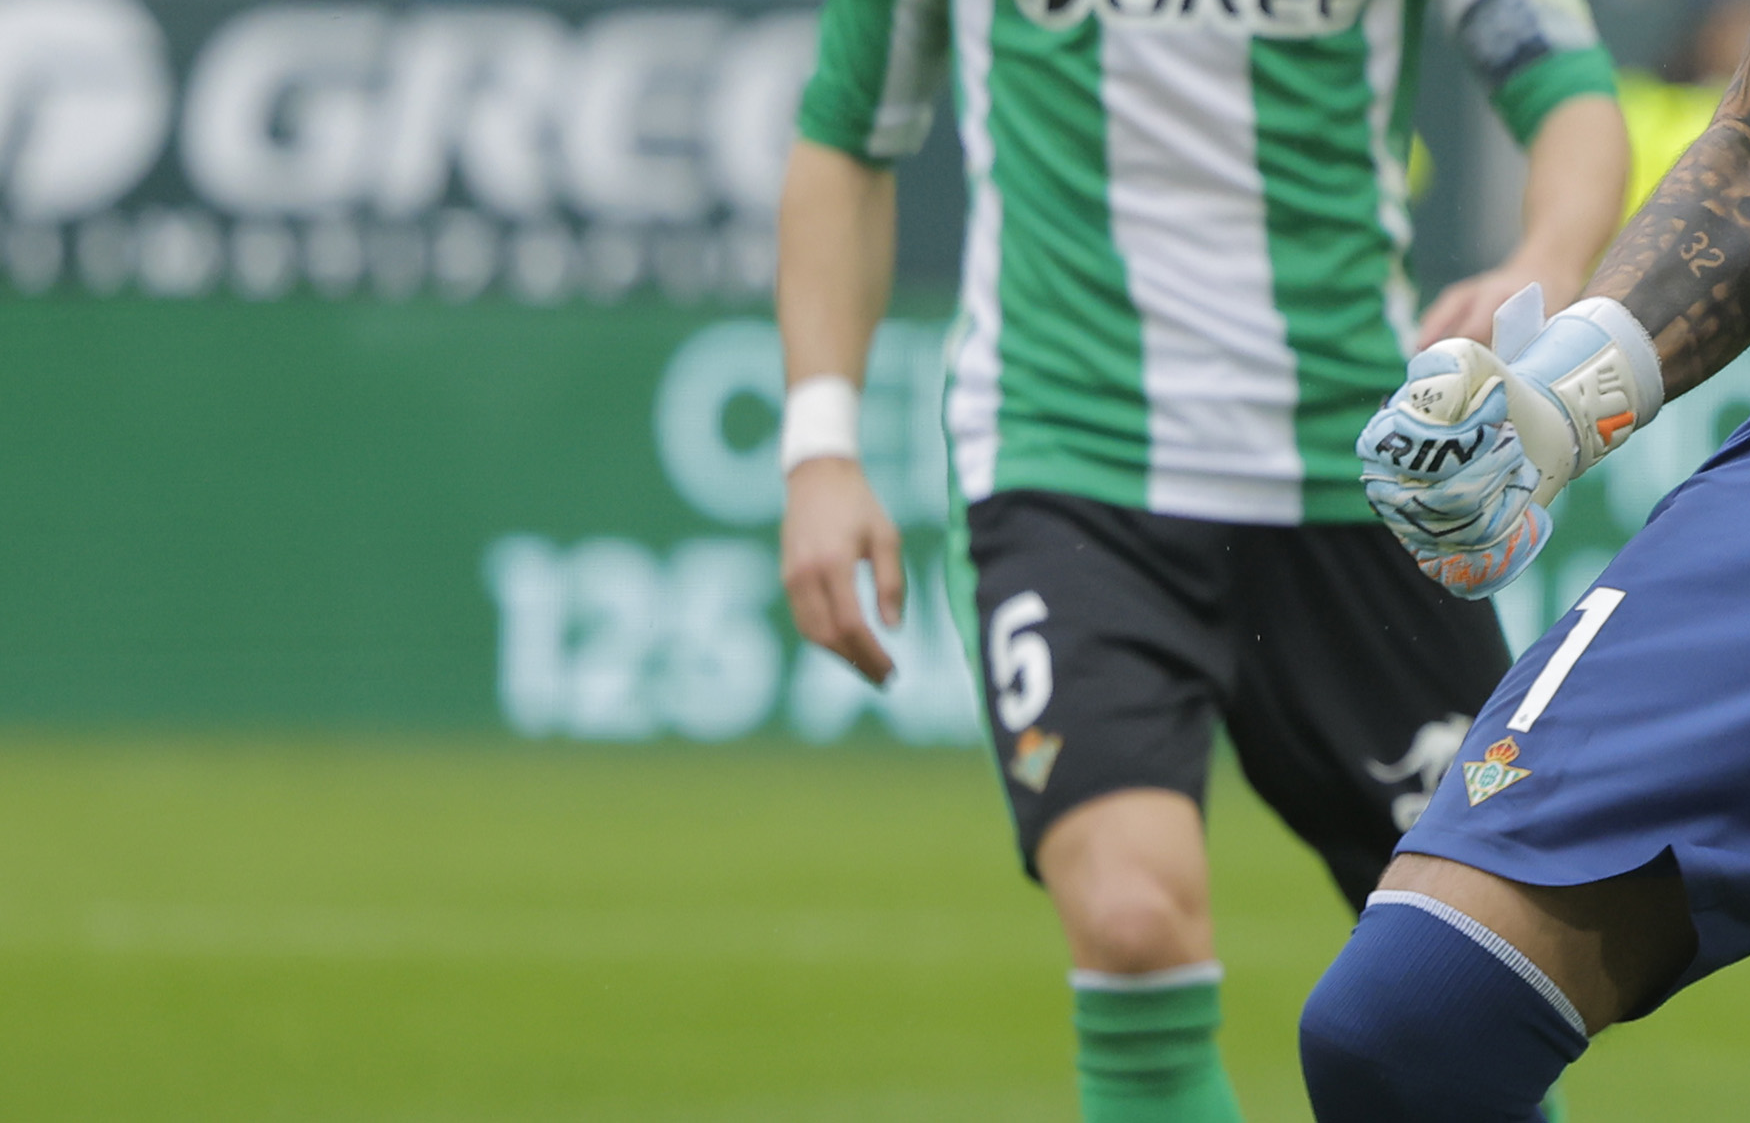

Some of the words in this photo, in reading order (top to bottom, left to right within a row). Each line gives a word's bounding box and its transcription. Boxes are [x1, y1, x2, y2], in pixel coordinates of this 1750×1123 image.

[1680, 231, 1725, 277] 32
[1375, 424, 1515, 474] RIN
[988, 590, 1054, 733] 5
[1507, 586, 1627, 733] 1
